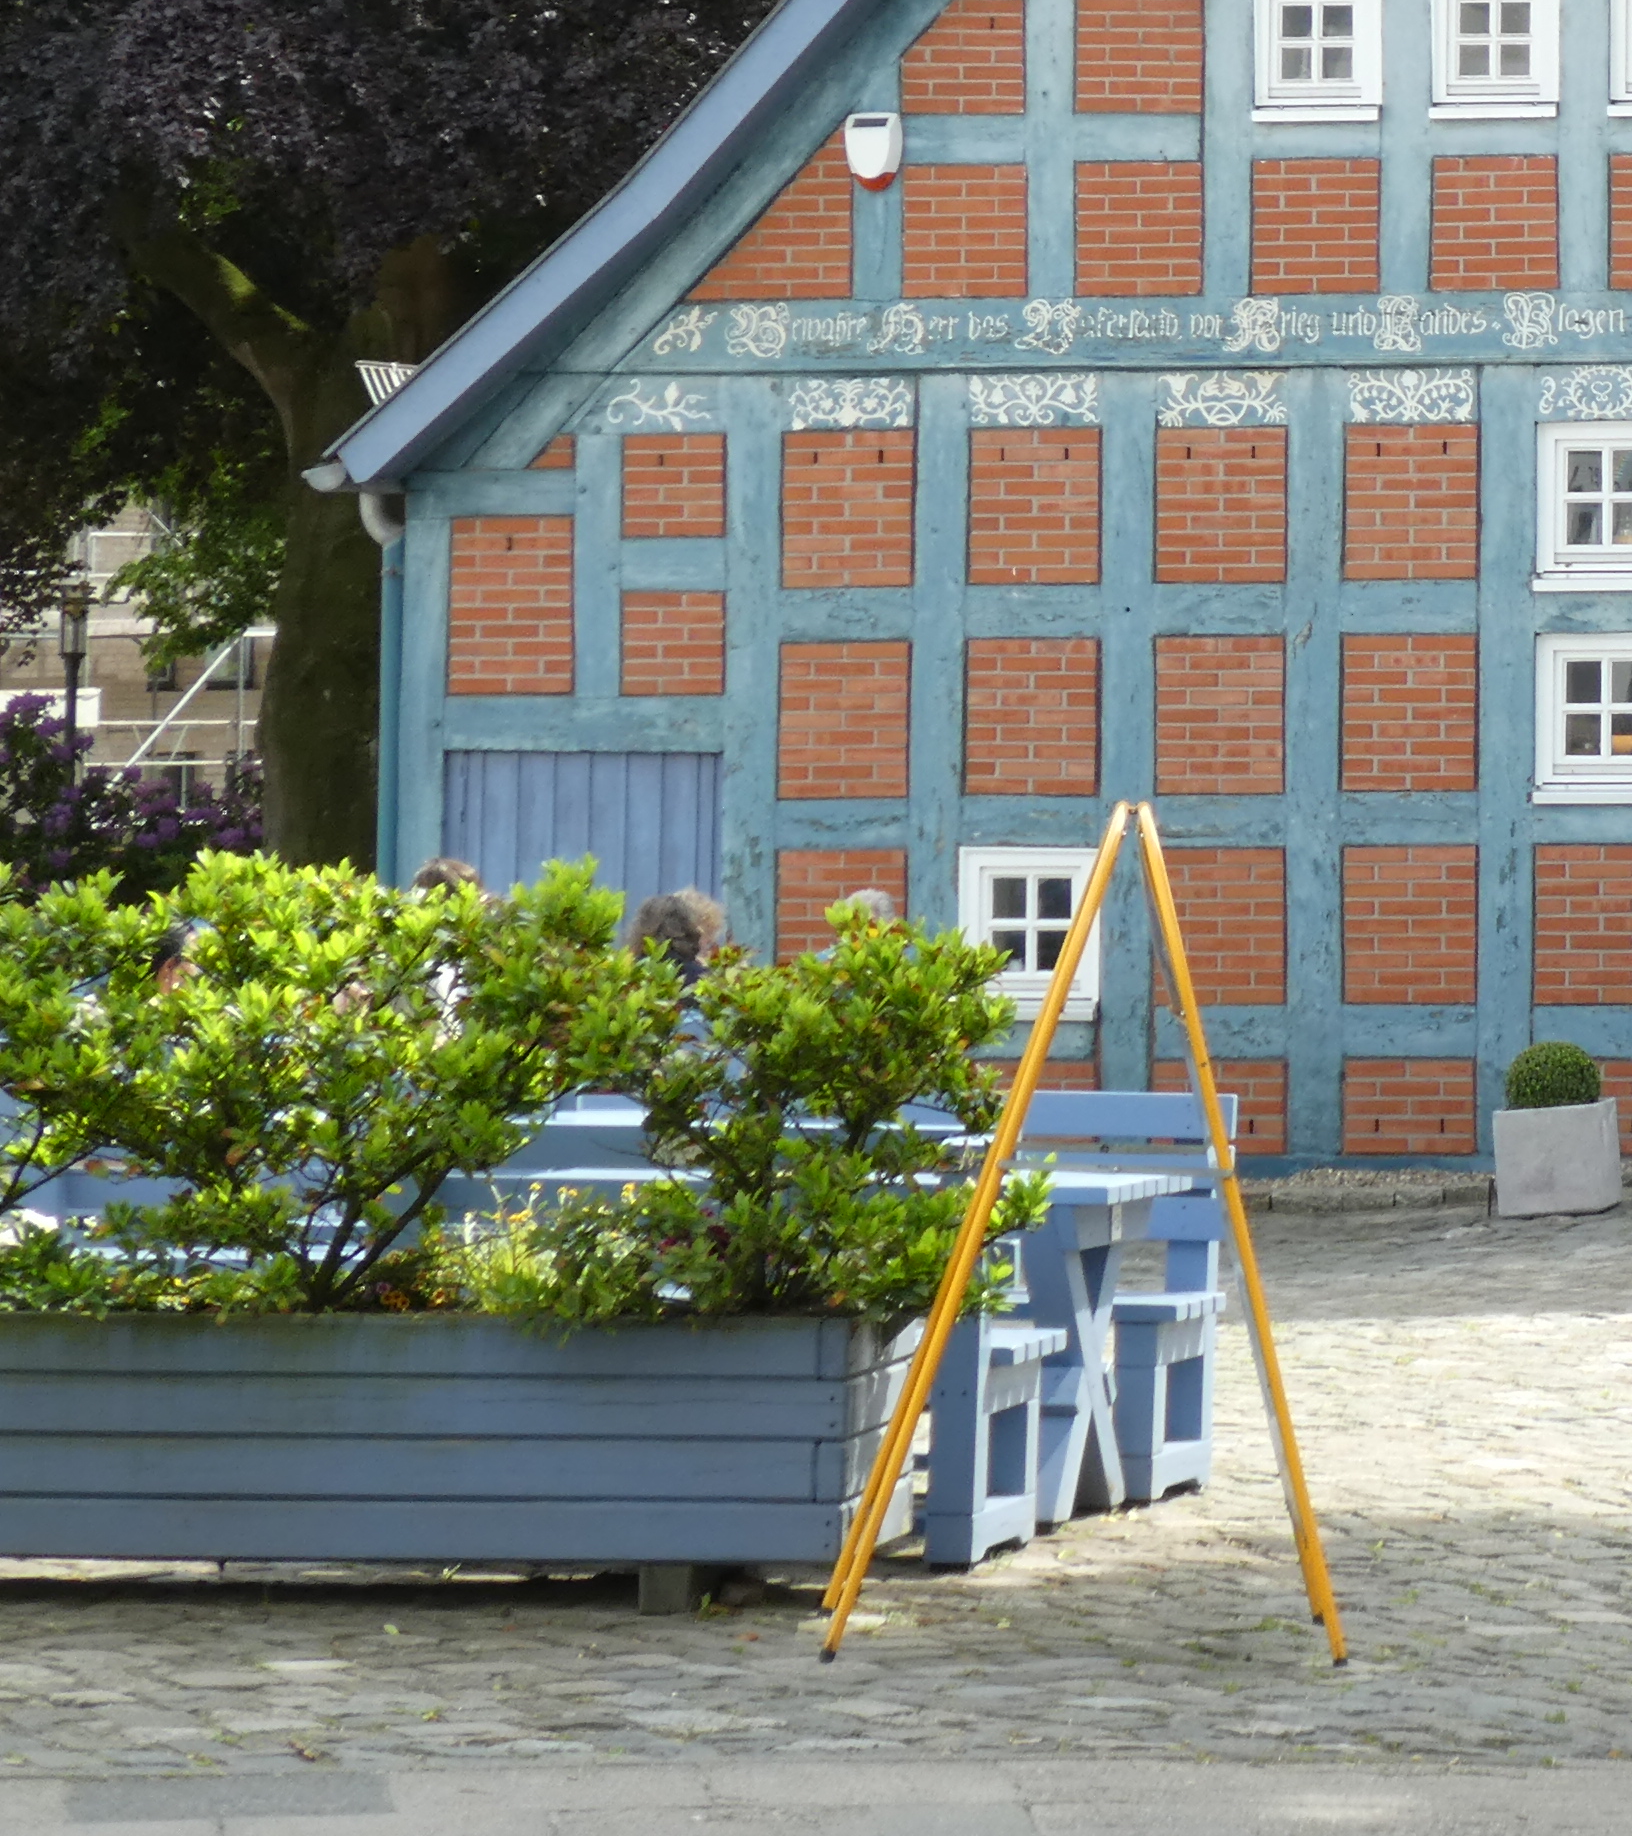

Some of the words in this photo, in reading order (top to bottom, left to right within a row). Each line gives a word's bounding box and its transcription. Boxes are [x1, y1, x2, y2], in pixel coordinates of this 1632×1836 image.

[724, 302, 867, 358] Bewahre
[867, 303, 959, 355] Herr
[968, 311, 1009, 340] das
[1190, 313, 1223, 339] vor
[1222, 296, 1320, 352] Krieg
[1332, 304, 1376, 336] und
